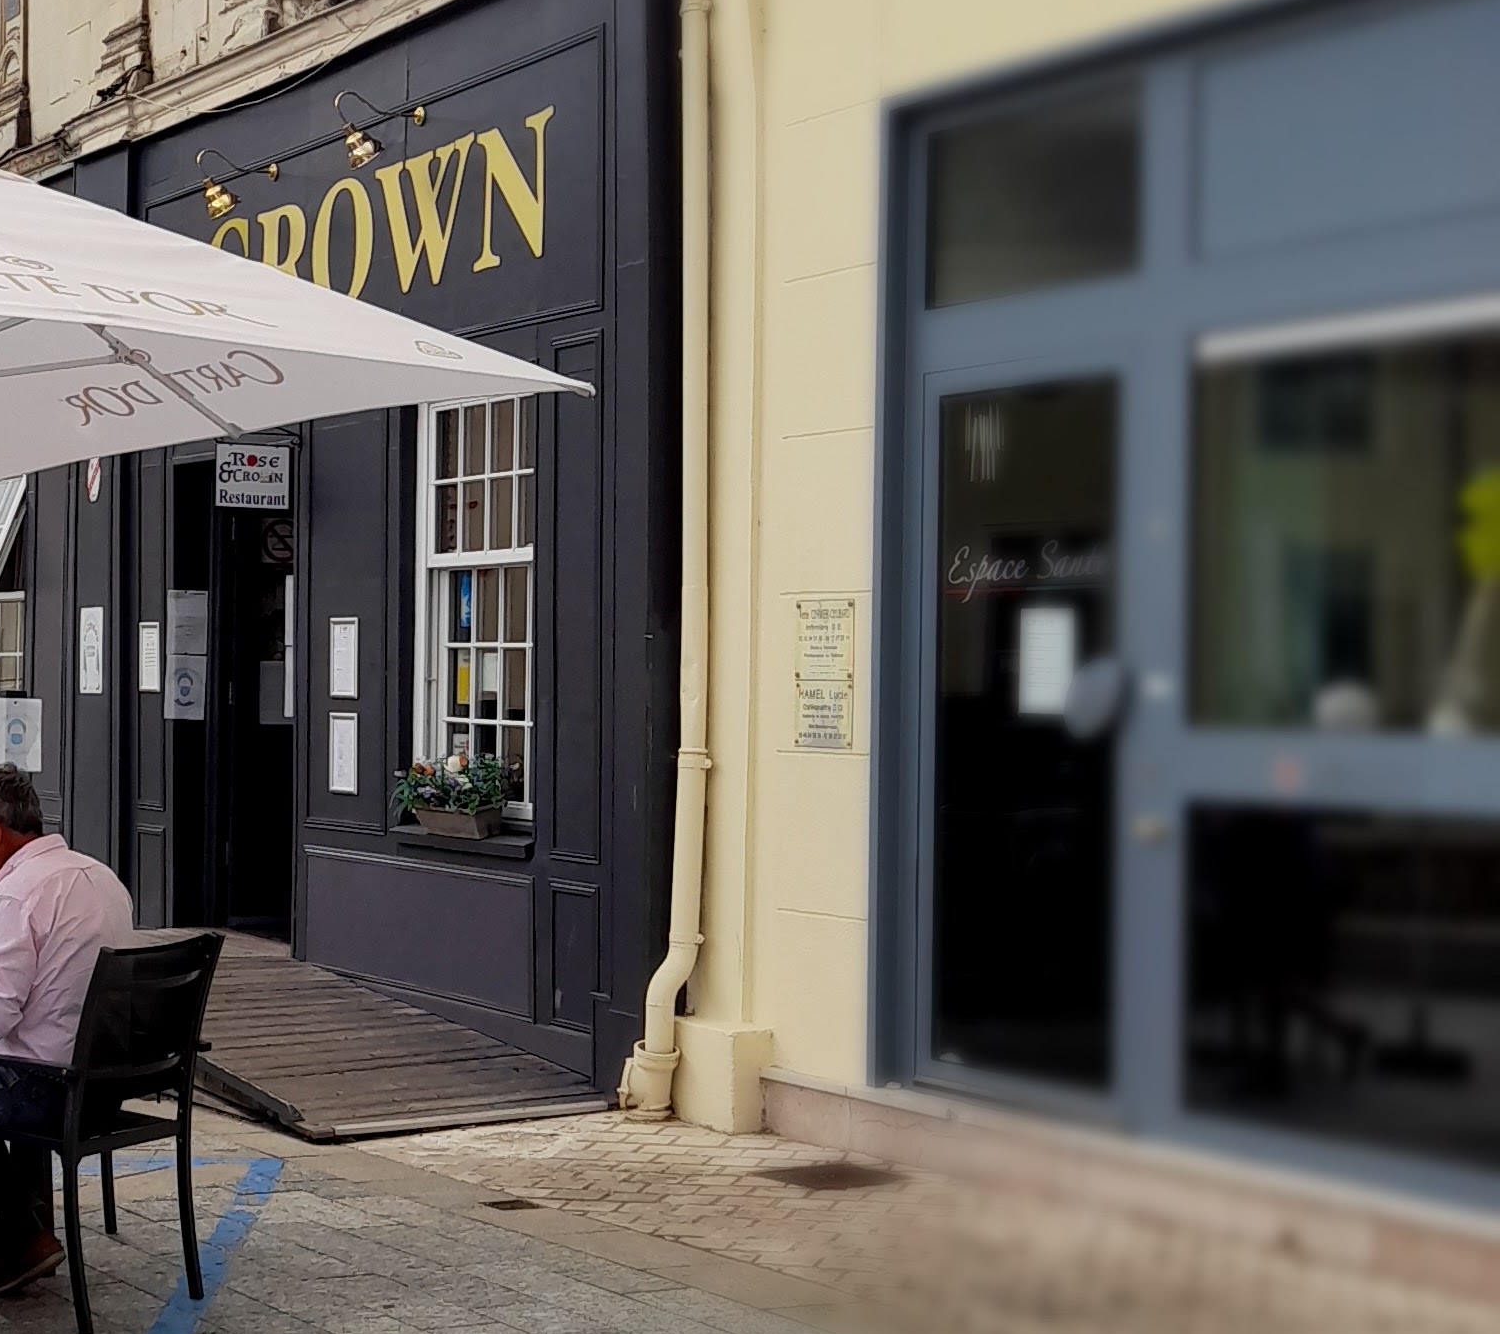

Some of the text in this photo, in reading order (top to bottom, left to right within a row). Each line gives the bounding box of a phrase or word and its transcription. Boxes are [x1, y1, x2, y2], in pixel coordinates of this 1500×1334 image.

[80, 282, 278, 328] D'OR
[219, 489, 286, 506] Restaurant
[948, 545, 1029, 603] Espace
